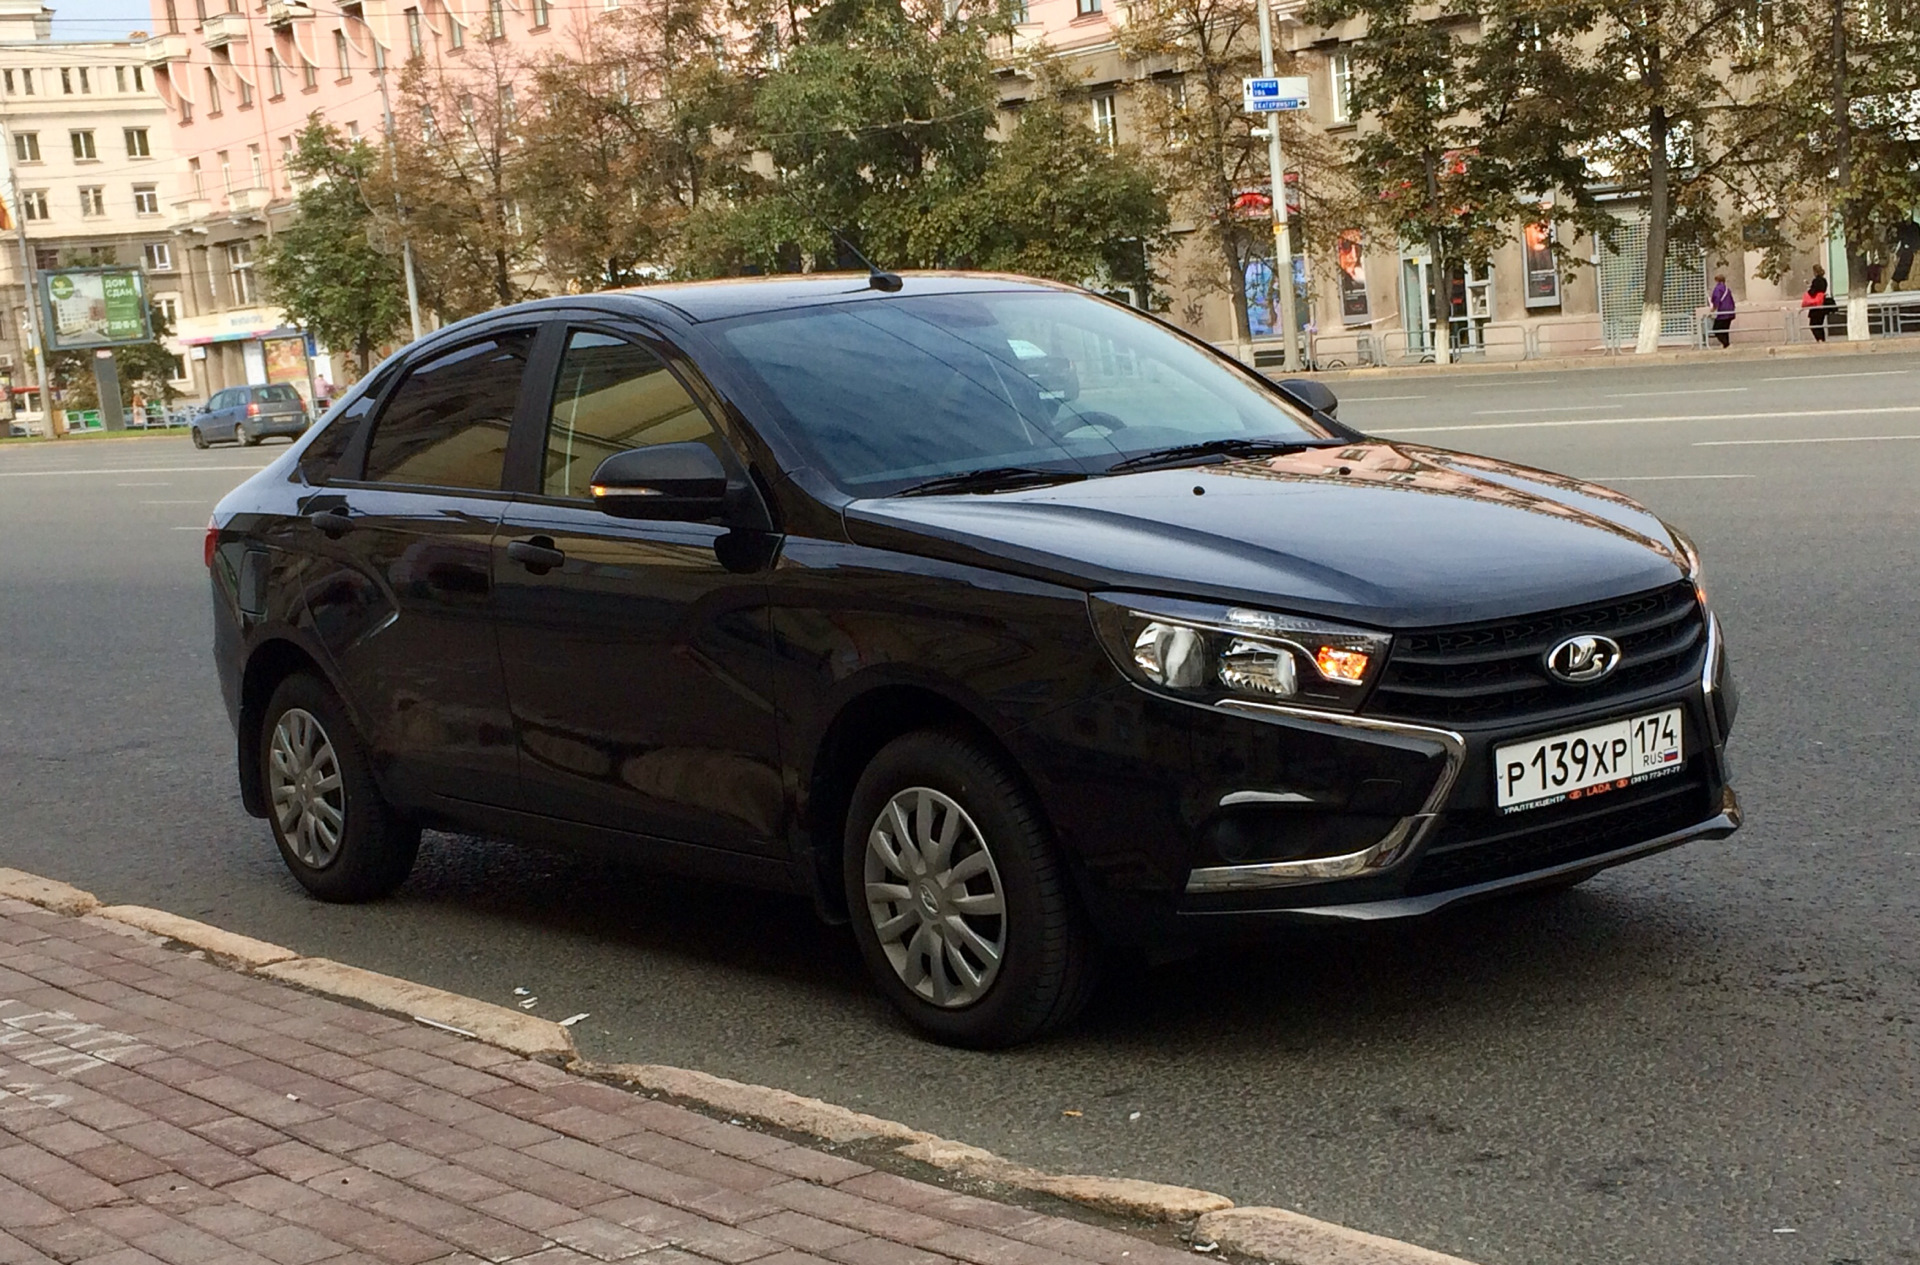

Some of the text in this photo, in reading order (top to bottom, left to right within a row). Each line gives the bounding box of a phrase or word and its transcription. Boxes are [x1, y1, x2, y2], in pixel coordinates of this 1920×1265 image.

[105, 279, 126, 288] ДОМ
[106, 288, 133, 298] СДАН
[1507, 714, 1674, 798] Р139ХР 174
[1642, 751, 1663, 768] RUS
[1504, 794, 1566, 815] УРАЛТЕХЦЕНТР
[1586, 782, 1612, 797] LADA
